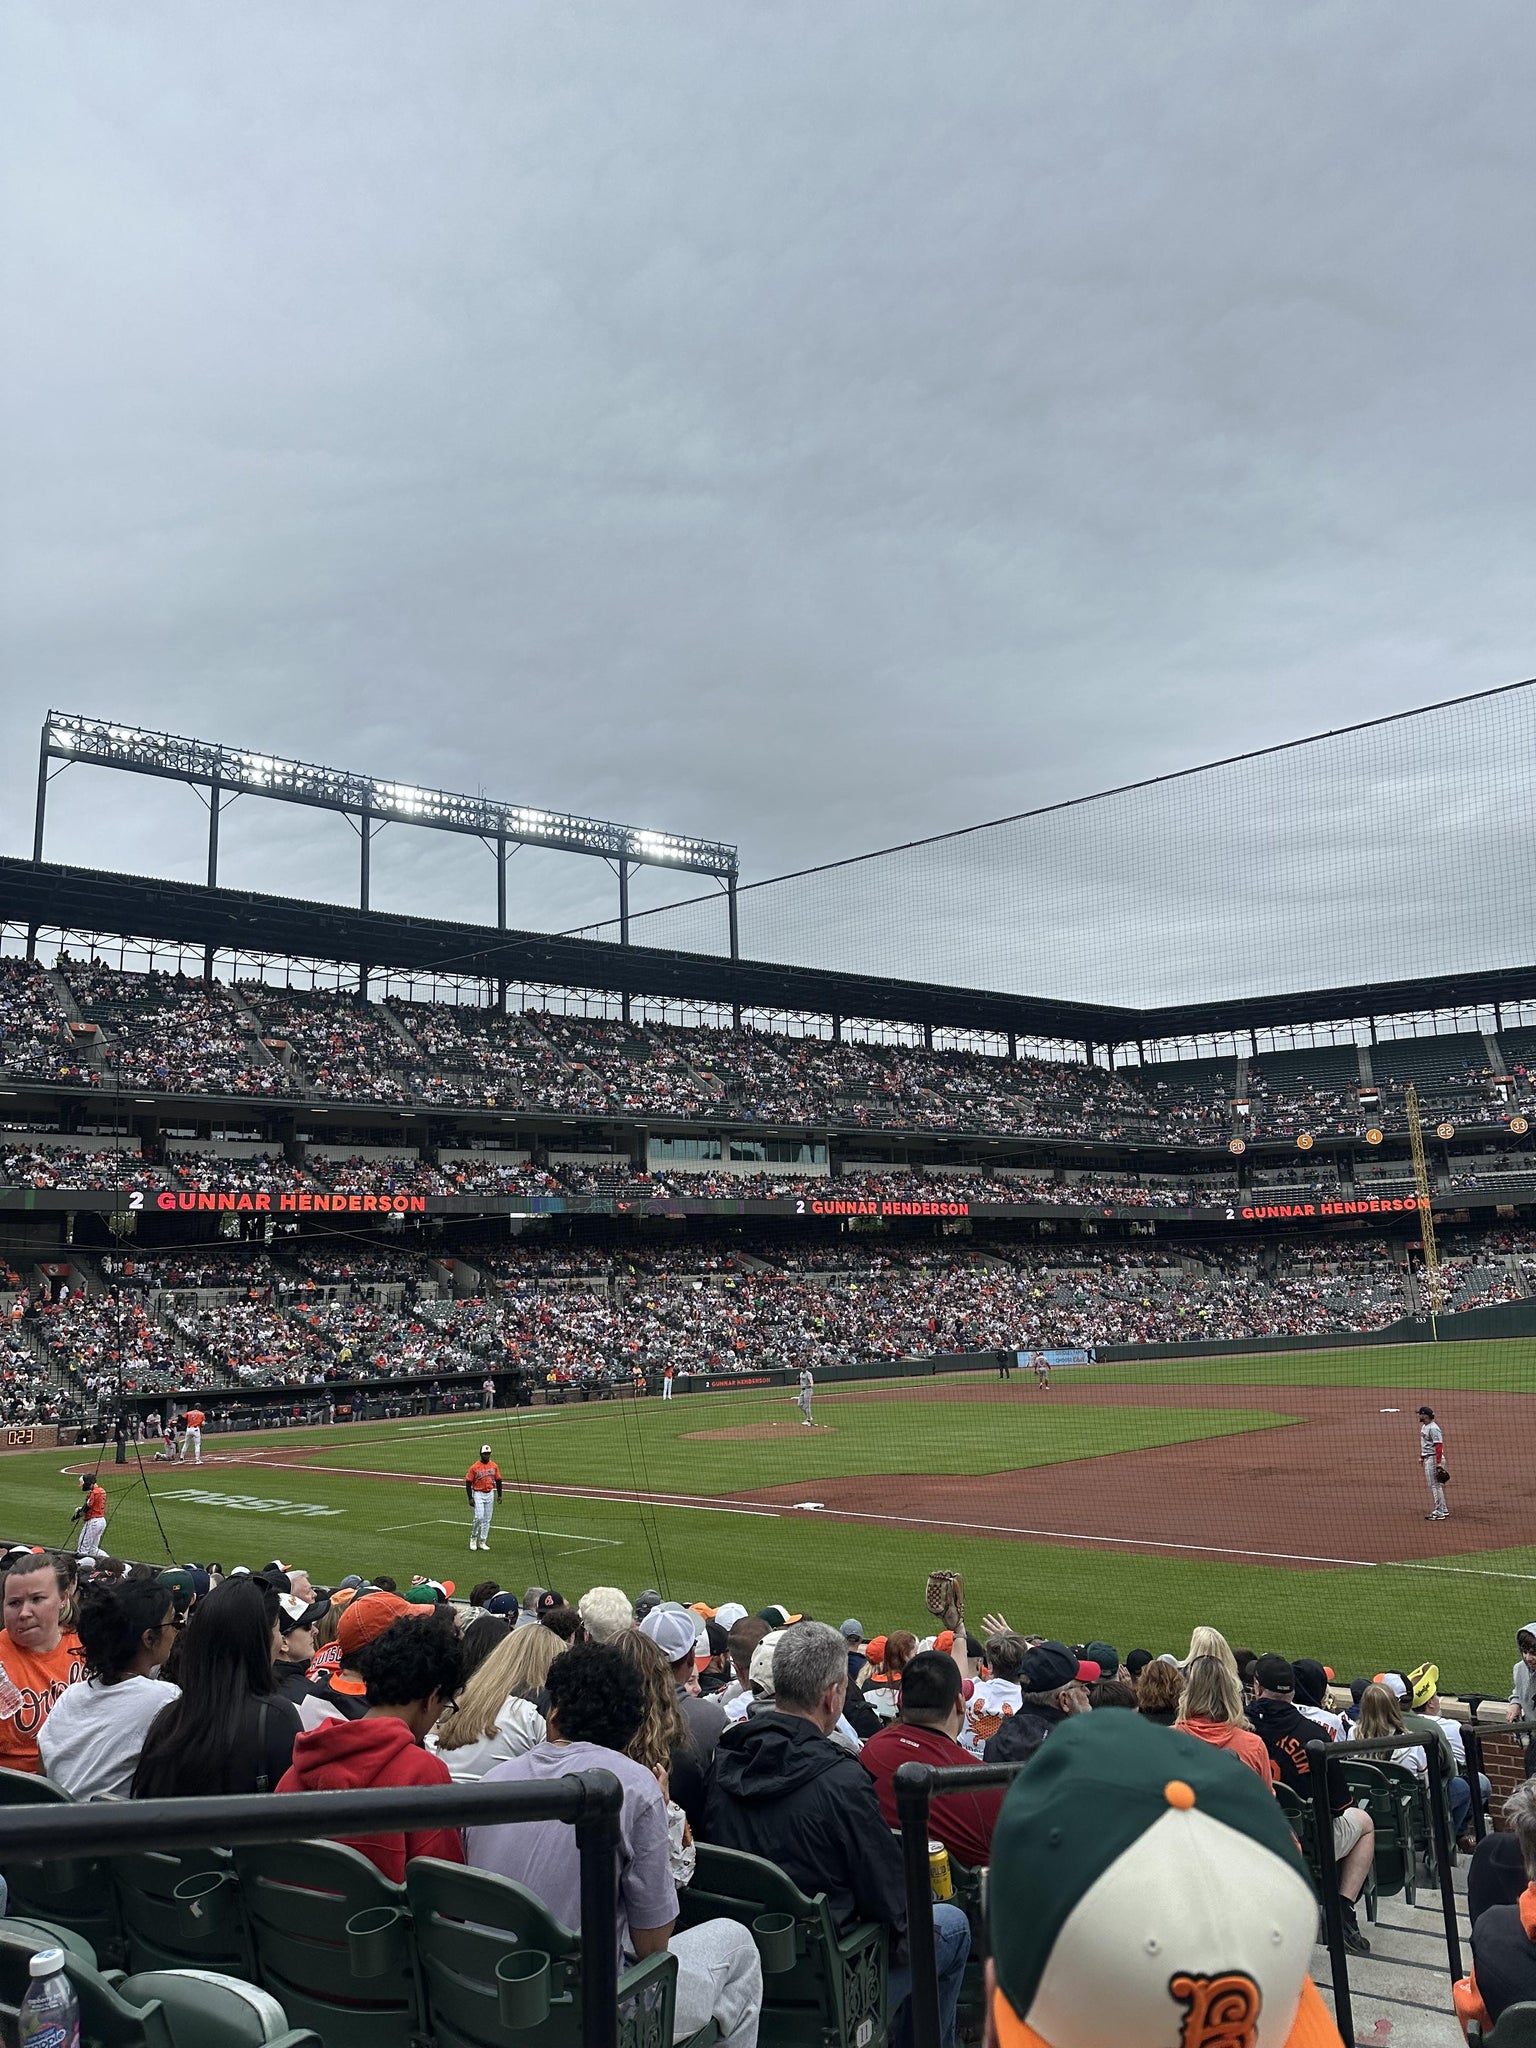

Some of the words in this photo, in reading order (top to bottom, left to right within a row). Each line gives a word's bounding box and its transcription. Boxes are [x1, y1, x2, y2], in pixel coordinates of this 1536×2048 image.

[1513, 1121, 1525, 1130] 33
[1440, 1127, 1452, 1136] 22
[1232, 1141, 1243, 1151] 20
[128, 1191, 144, 1209] 2
[157, 1193, 271, 1211] GUNNAR
[280, 1194, 426, 1211] HENDERSON
[796, 1200, 806, 1214] 2
[811, 1201, 877, 1214] GUNNAR
[882, 1202, 969, 1215] HENDERSON
[1225, 1208, 1235, 1220] 2
[1241, 1204, 1315, 1219] GUNNAR
[1321, 1197, 1430, 1215] HENDERSON
[736, 1377, 771, 1385] HENDERSON
